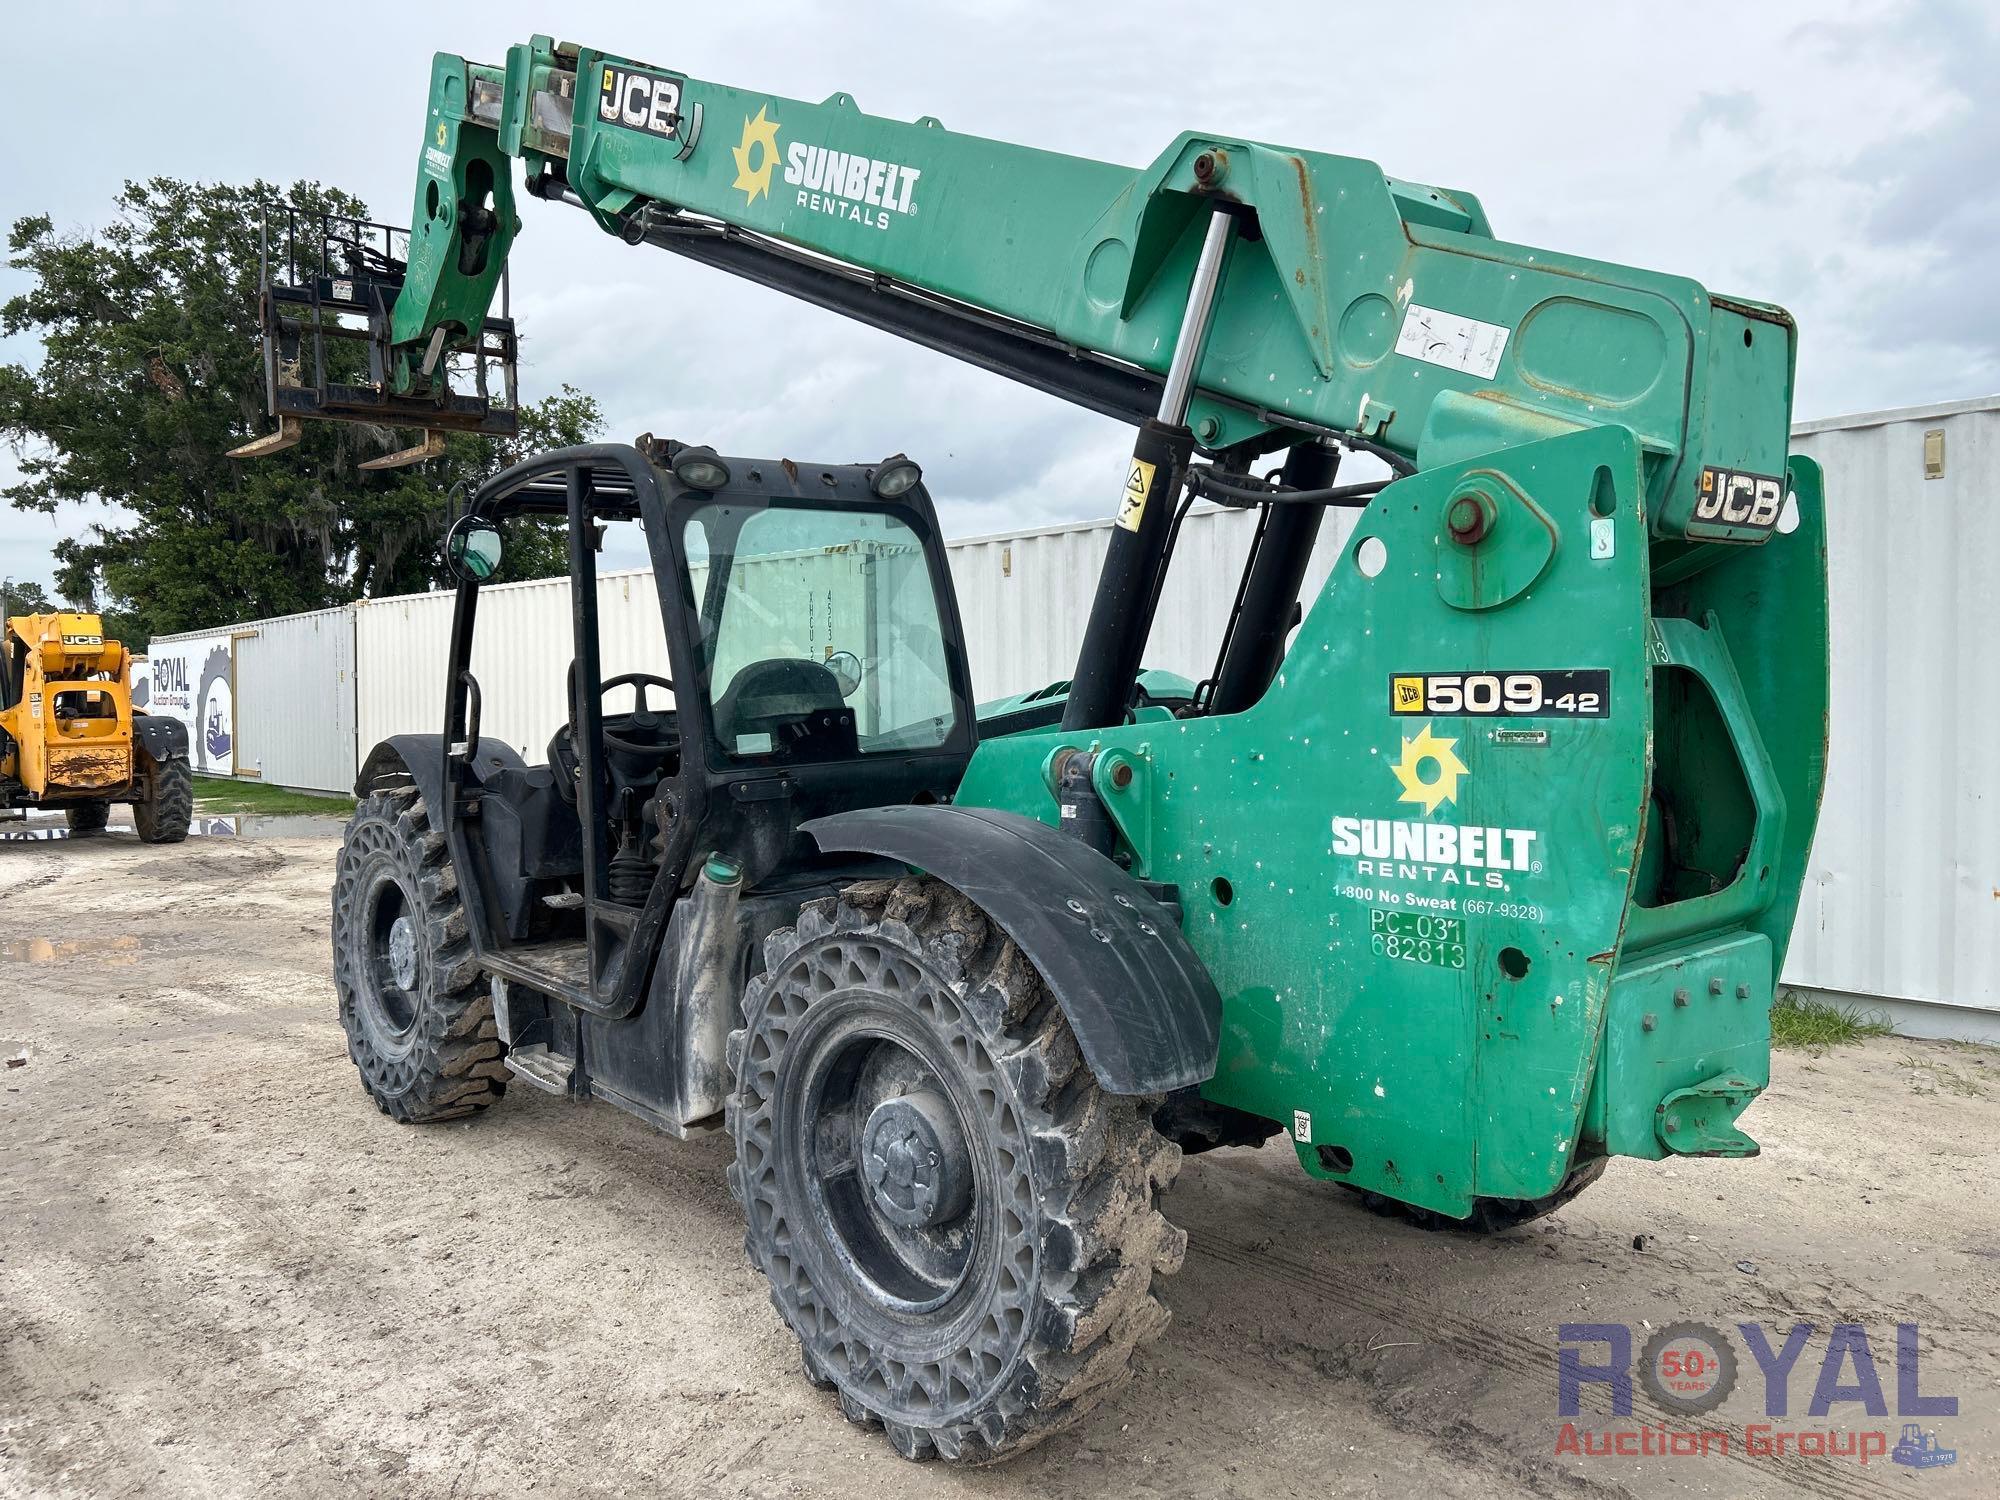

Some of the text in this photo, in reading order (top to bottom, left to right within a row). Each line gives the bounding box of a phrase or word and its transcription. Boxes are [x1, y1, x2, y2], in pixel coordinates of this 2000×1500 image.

[600, 72, 680, 133] JCB
[796, 190, 890, 230] RENTALS
[1696, 472, 1780, 526] JCB
[64, 635, 102, 645] JCB
[153, 657, 190, 692] ROYAL
[1402, 686, 1419, 701] JCB
[1427, 675, 1600, 713] 509-42
[1331, 816, 1537, 871] SUNBELT
[1358, 860, 1505, 889] RENTALS
[1332, 885, 1544, 923] 1-800 No Sweat (667-9328)
[1371, 909, 1461, 943] PC-031
[1371, 933, 1466, 969] 682813
